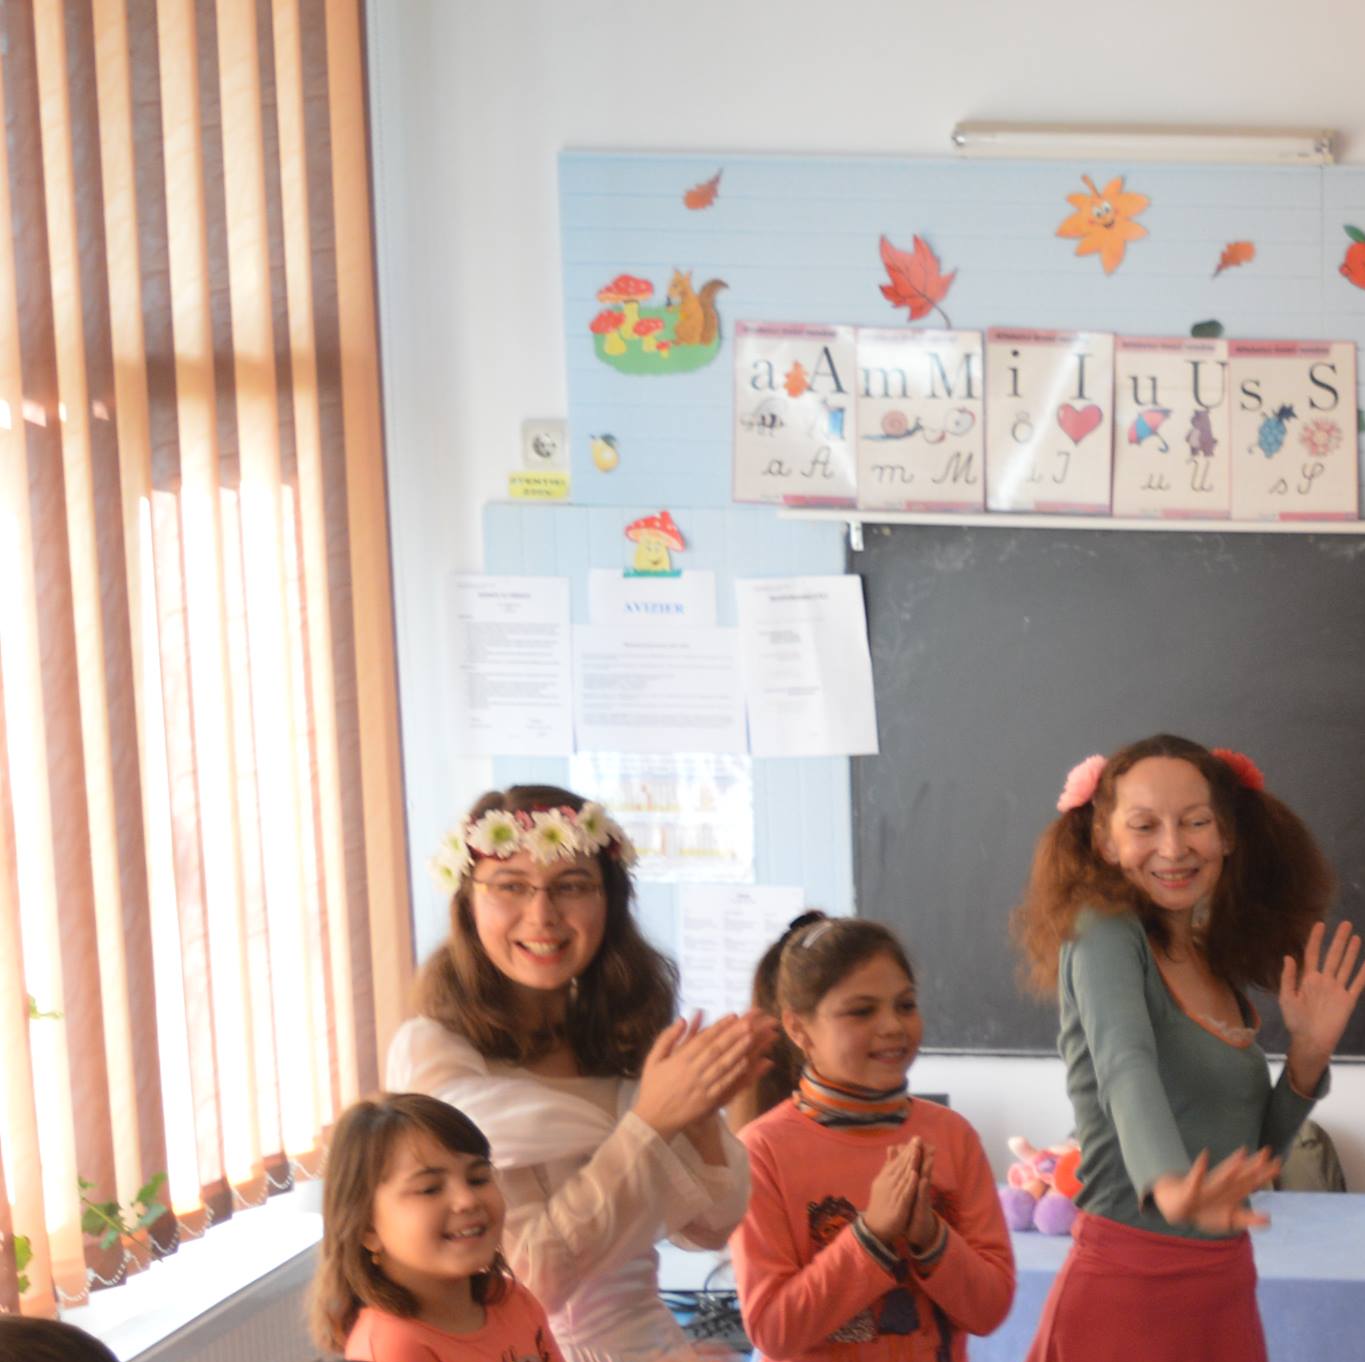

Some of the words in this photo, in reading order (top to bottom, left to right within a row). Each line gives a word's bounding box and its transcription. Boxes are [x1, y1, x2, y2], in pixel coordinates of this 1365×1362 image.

[751, 359, 775, 391] a
[807, 346, 848, 393] A
[860, 368, 910, 398] m
[927, 352, 982, 399] M
[1008, 350, 1021, 398] i
[1071, 353, 1095, 400] I
[1129, 375, 1158, 406] u
[1185, 360, 1228, 409] U
[1240, 379, 1262, 411] s
[1309, 362, 1339, 411] S
[931, 452, 978, 484] M
